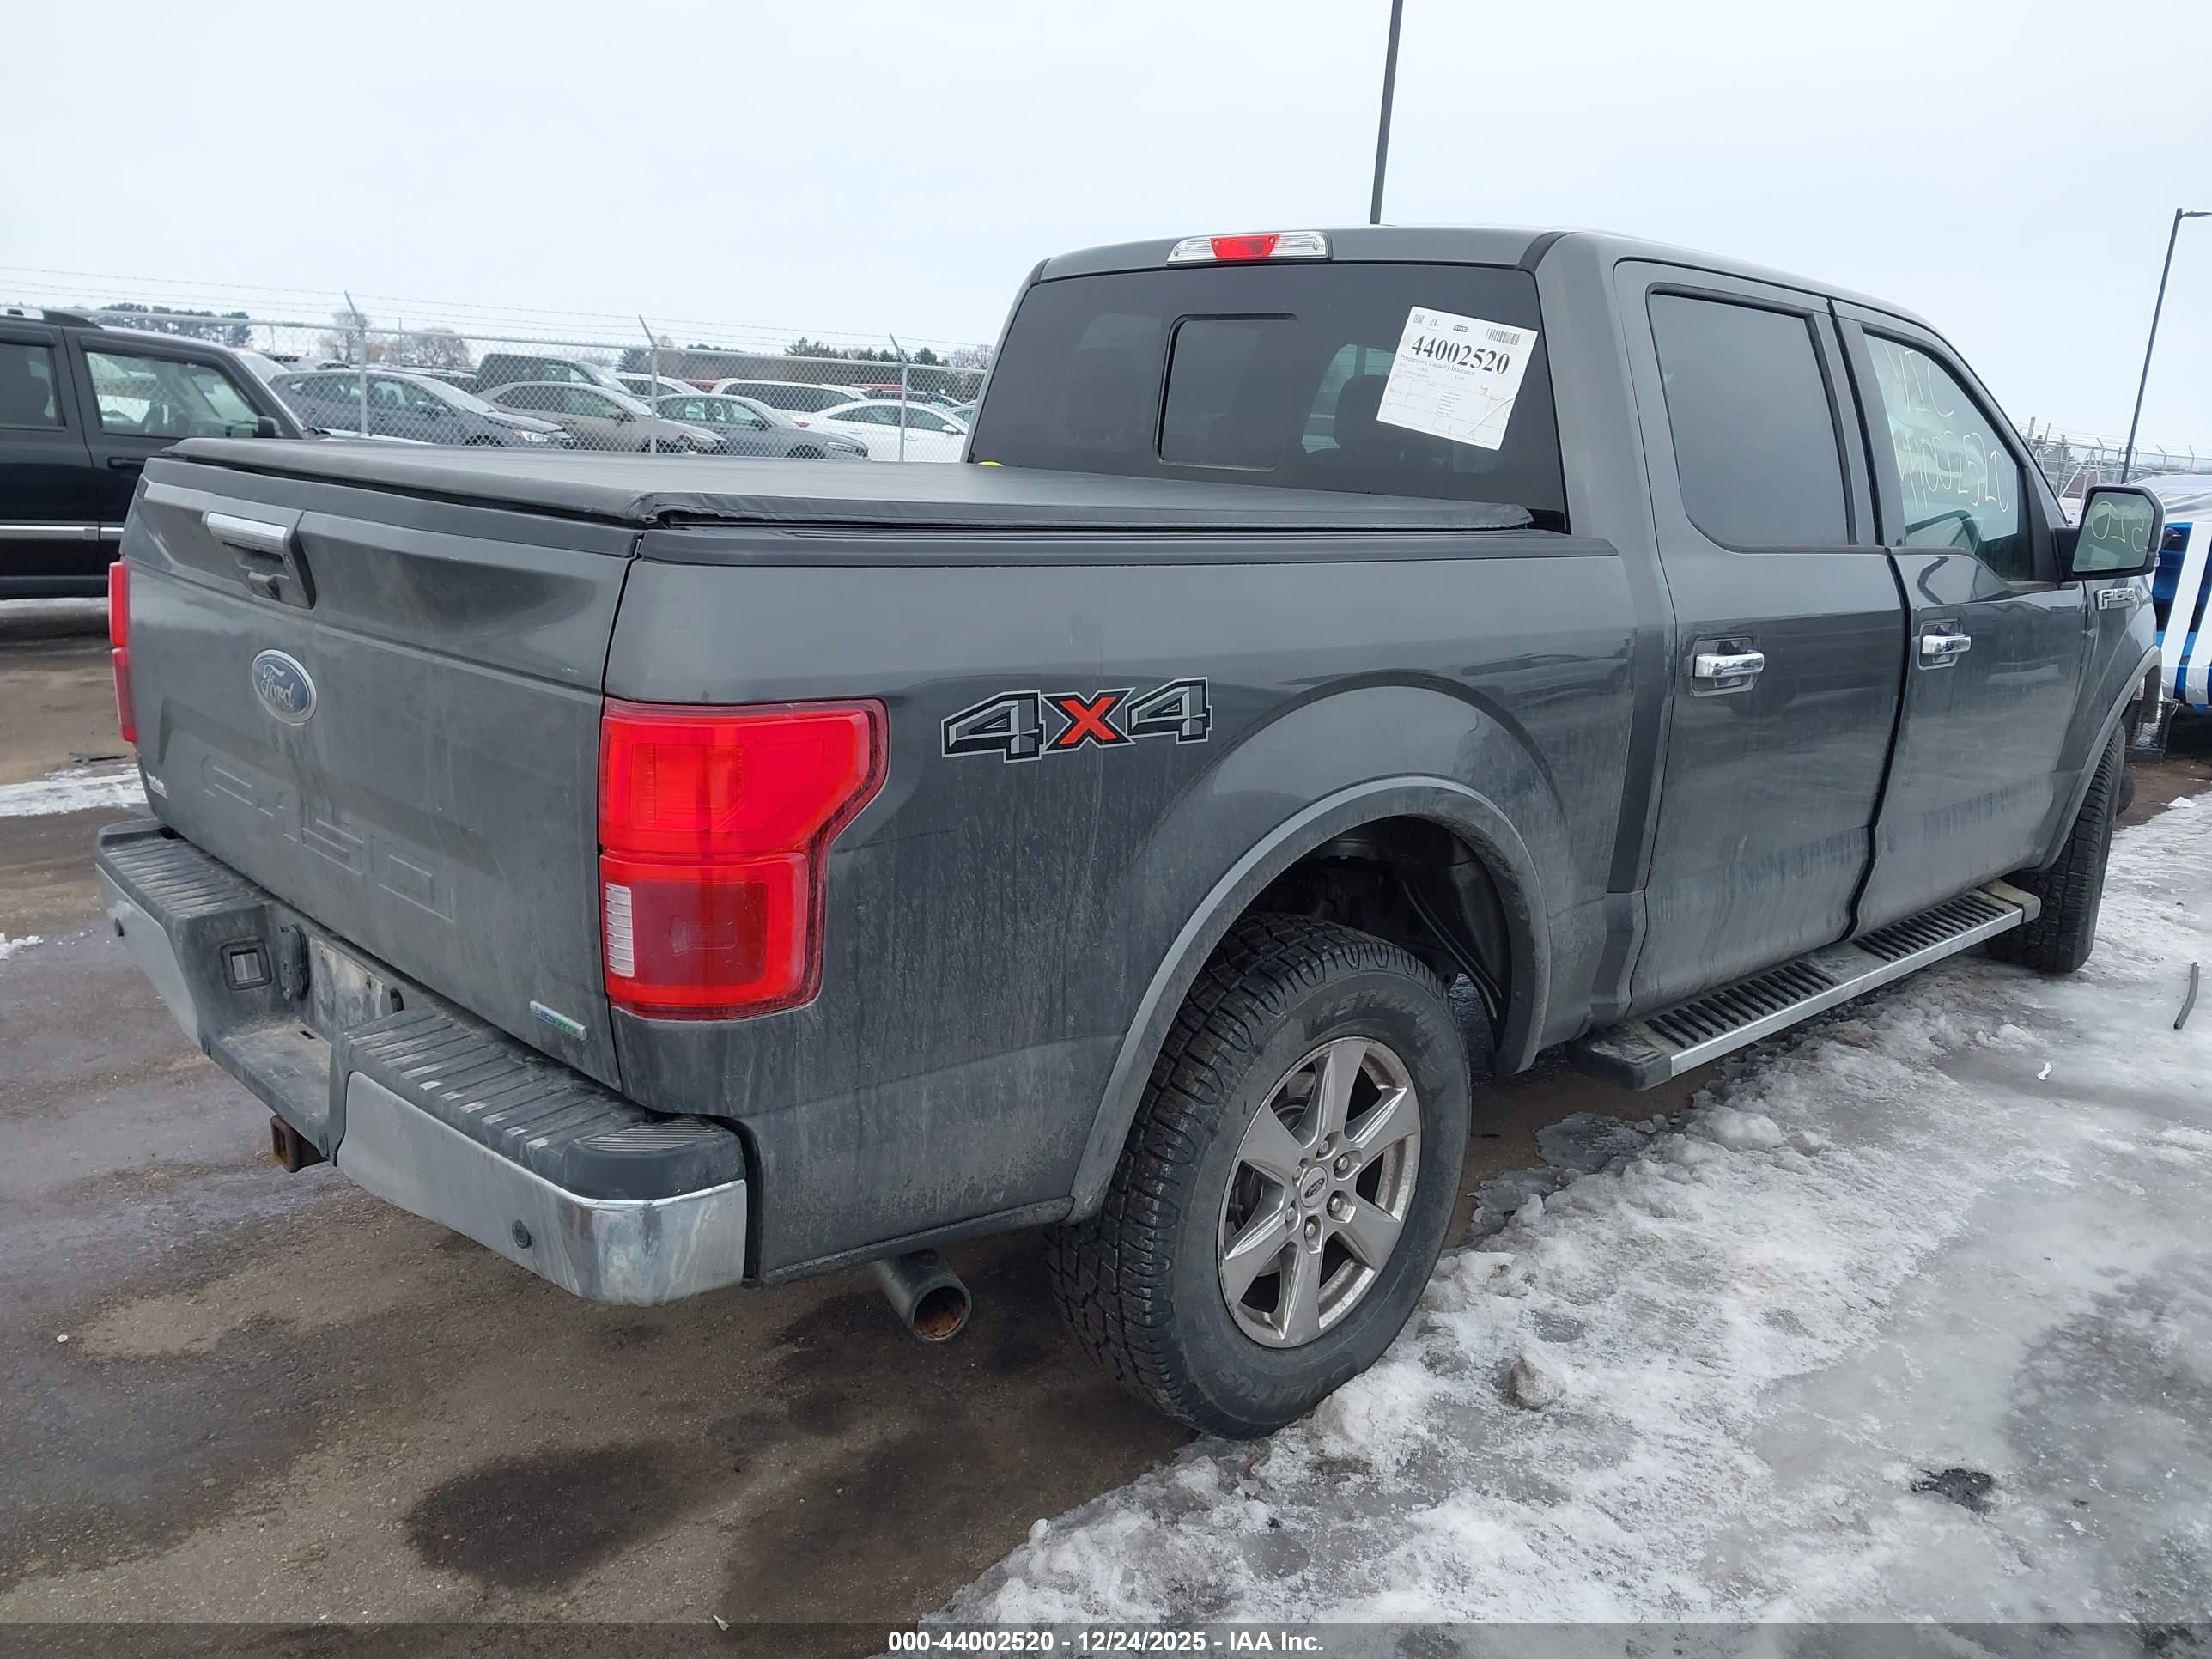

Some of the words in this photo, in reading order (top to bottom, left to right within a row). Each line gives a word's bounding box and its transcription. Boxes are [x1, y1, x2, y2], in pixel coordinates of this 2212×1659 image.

[1400, 354, 1429, 368] Progressive
[1451, 365, 1476, 377] Insurance
[1411, 335, 1510, 375] 44002520
[260, 663, 295, 708] Ford
